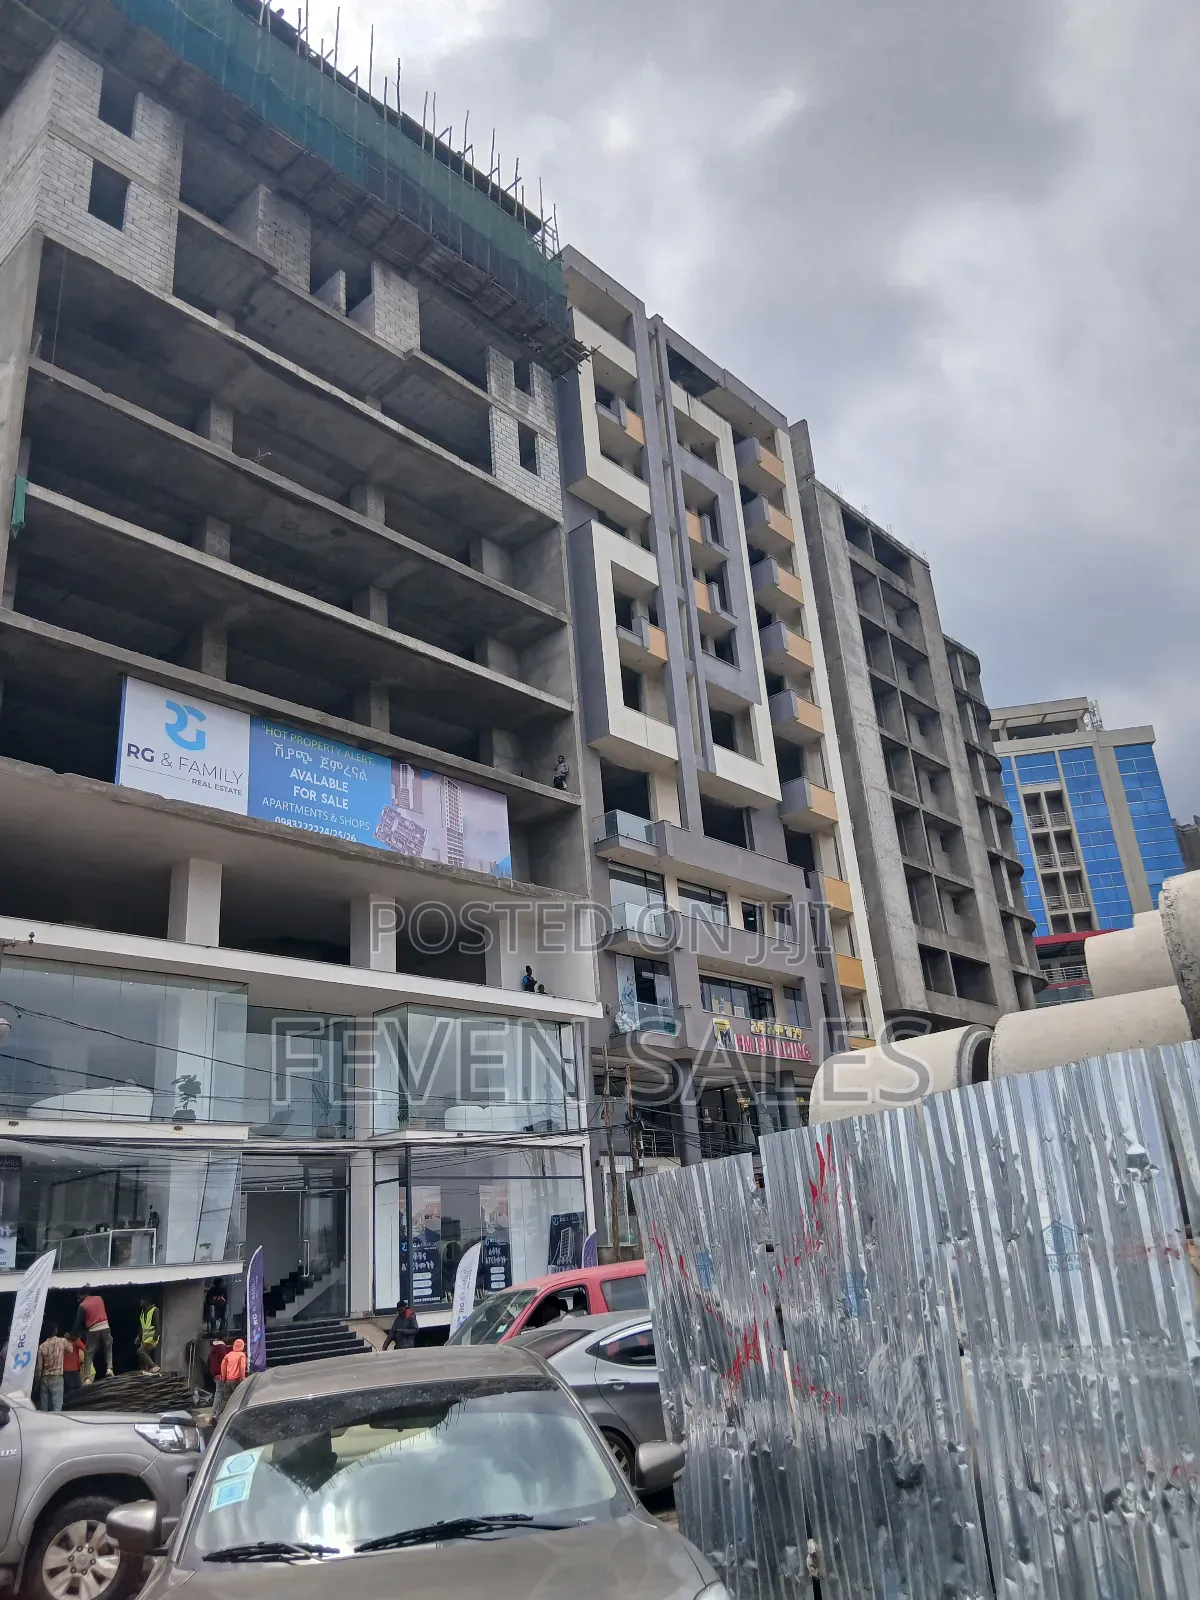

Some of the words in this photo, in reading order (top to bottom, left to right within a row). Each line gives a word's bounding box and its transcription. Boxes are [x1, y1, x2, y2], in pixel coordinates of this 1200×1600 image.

[290, 733, 342, 756] PROPERTY
[127, 743, 155, 763] RG
[161, 752, 173, 769] &
[179, 756, 244, 785] FAMILY
[191, 778, 213, 789] REAL
[214, 783, 243, 796] ESTATE
[290, 767, 349, 793] AVALABLE
[293, 785, 317, 801] FOR
[321, 793, 349, 810] SALE
[262, 796, 329, 821] APARTMENTS
[330, 812, 338, 823] &
[340, 815, 370, 831] SHOPS
[17, 1334, 26, 1348] RG
[22, 1289, 35, 1323] FAMILY
